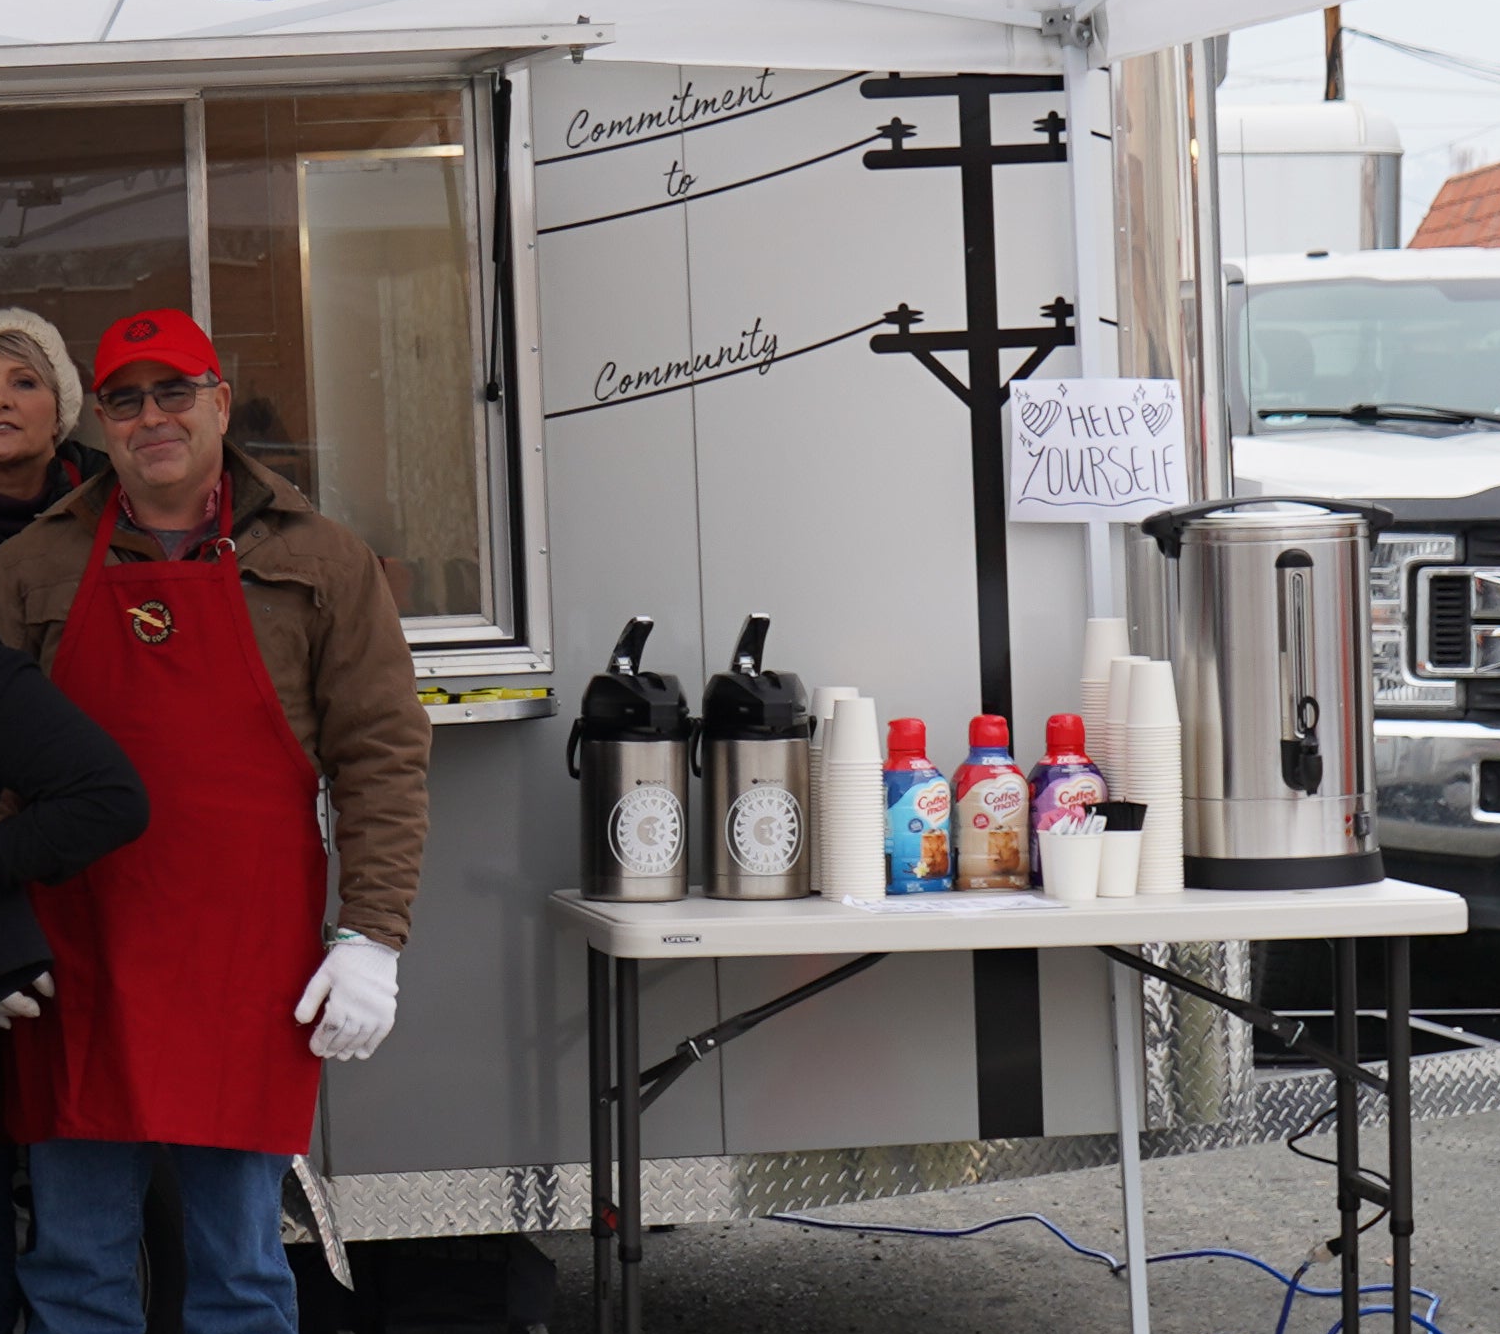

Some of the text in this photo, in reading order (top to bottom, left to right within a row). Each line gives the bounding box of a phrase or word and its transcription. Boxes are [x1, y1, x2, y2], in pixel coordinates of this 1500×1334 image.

[566, 67, 776, 149] Commitment
[663, 160, 699, 197] to
[594, 317, 780, 403] Community
[1066, 404, 1135, 439] HELP
[917, 793, 950, 810] Coffee
[984, 790, 1021, 805] Coffee
[1058, 790, 1097, 806] Coffee
